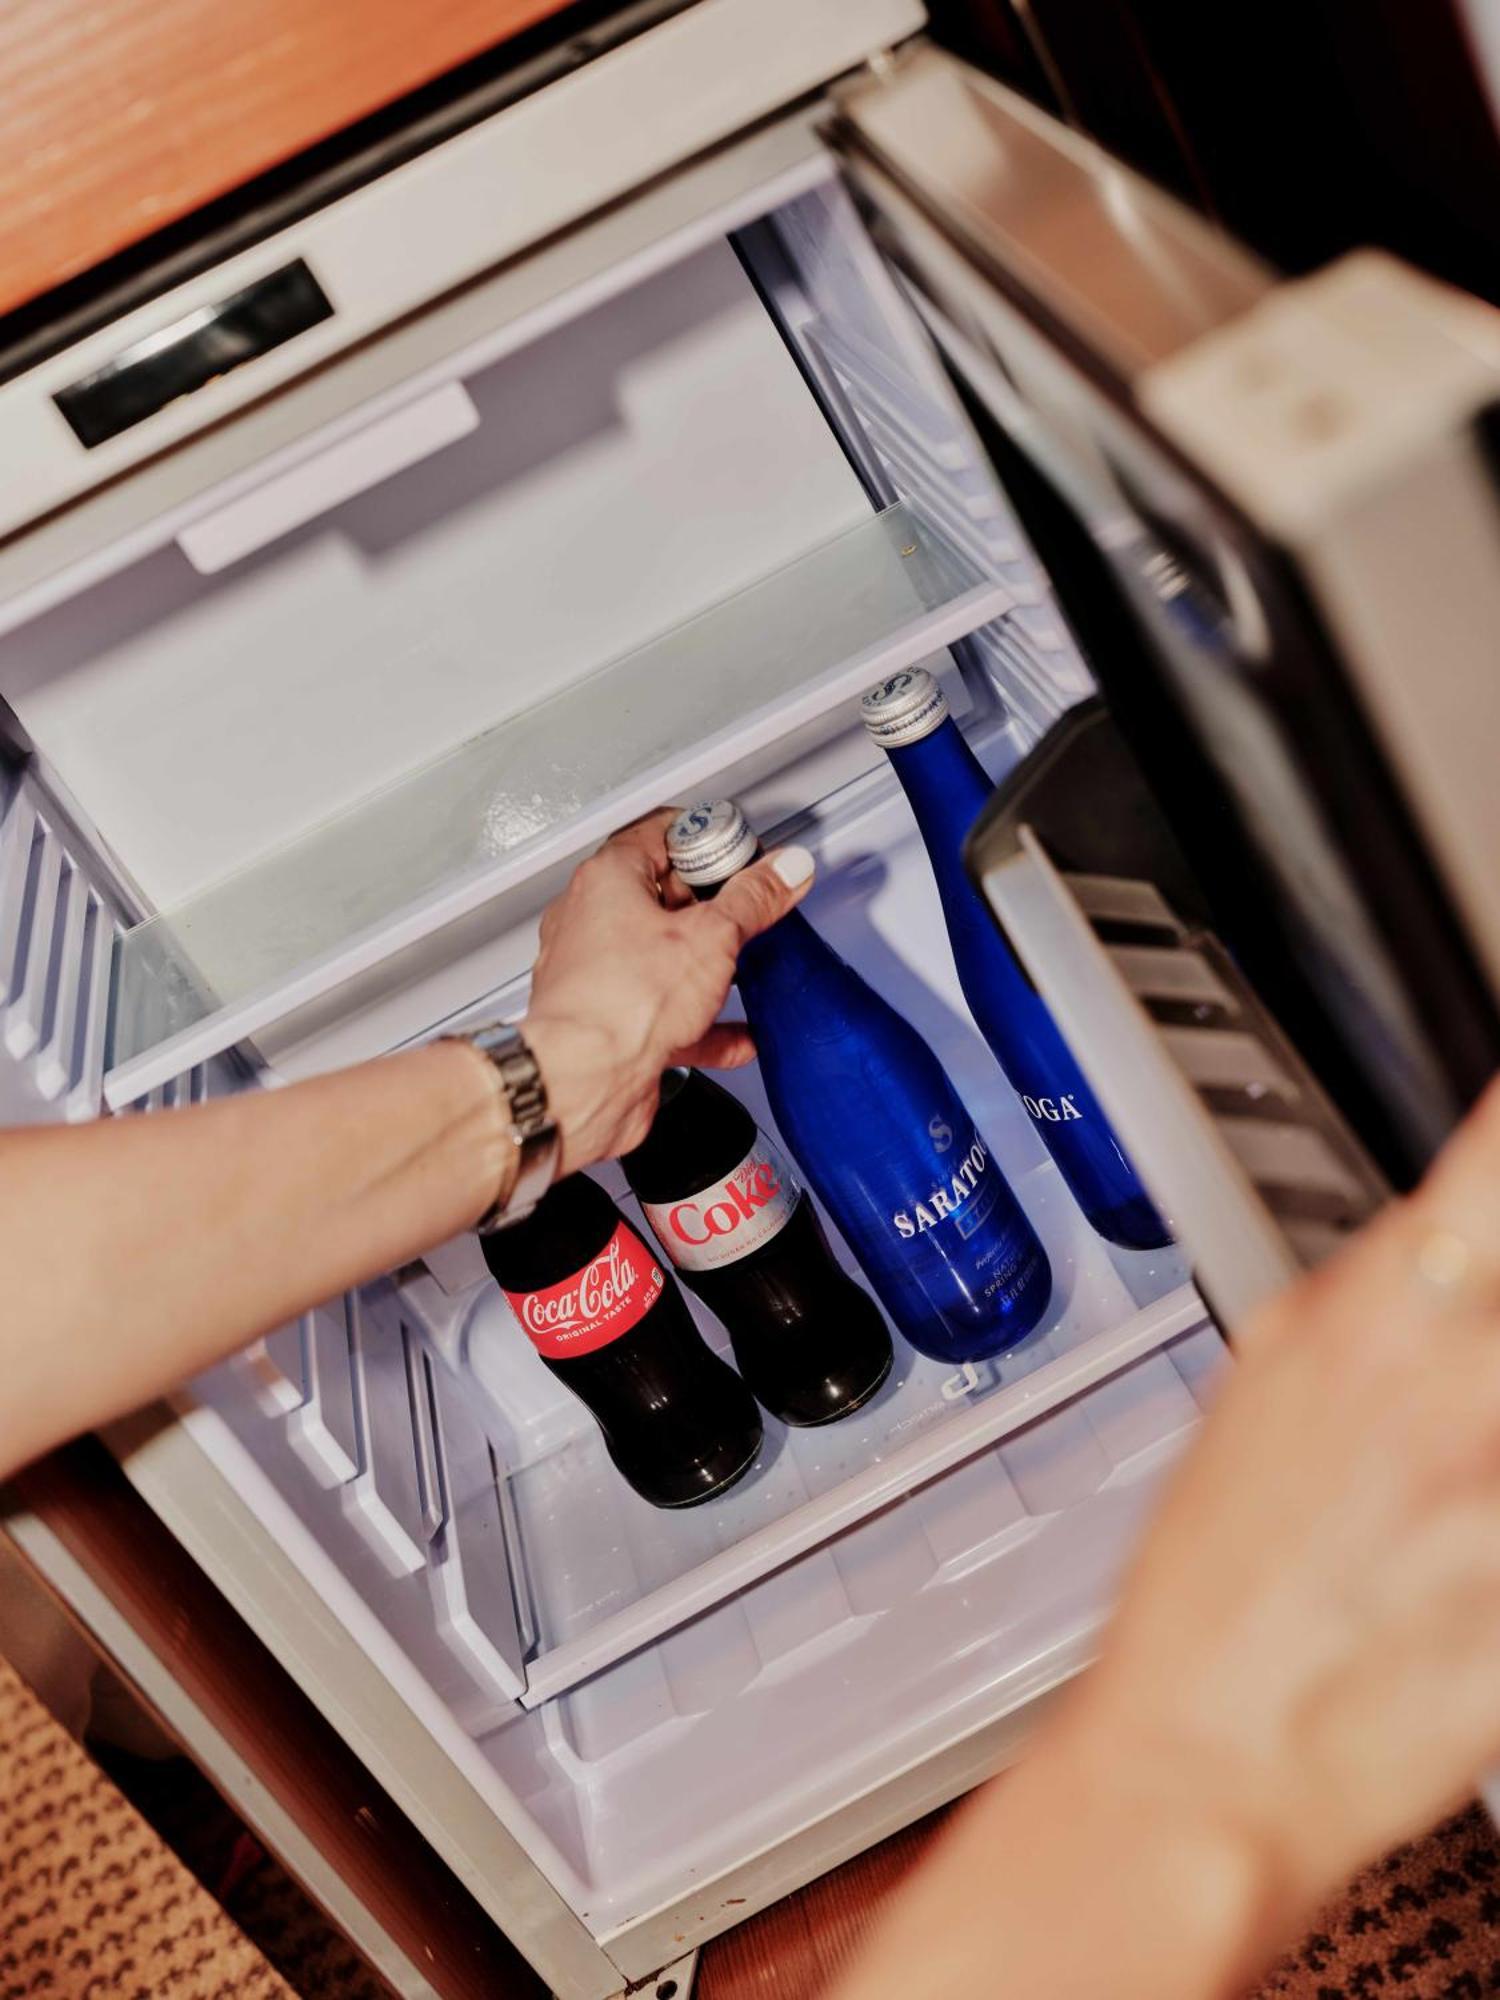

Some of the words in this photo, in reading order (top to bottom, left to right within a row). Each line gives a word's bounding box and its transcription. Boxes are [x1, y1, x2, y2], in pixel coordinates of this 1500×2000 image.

[669, 1163, 780, 1246] Coke
[523, 1236, 637, 1334] Coca-Cola
[556, 1319, 604, 1343] ORIGINAL
[603, 1297, 633, 1321] TASTE
